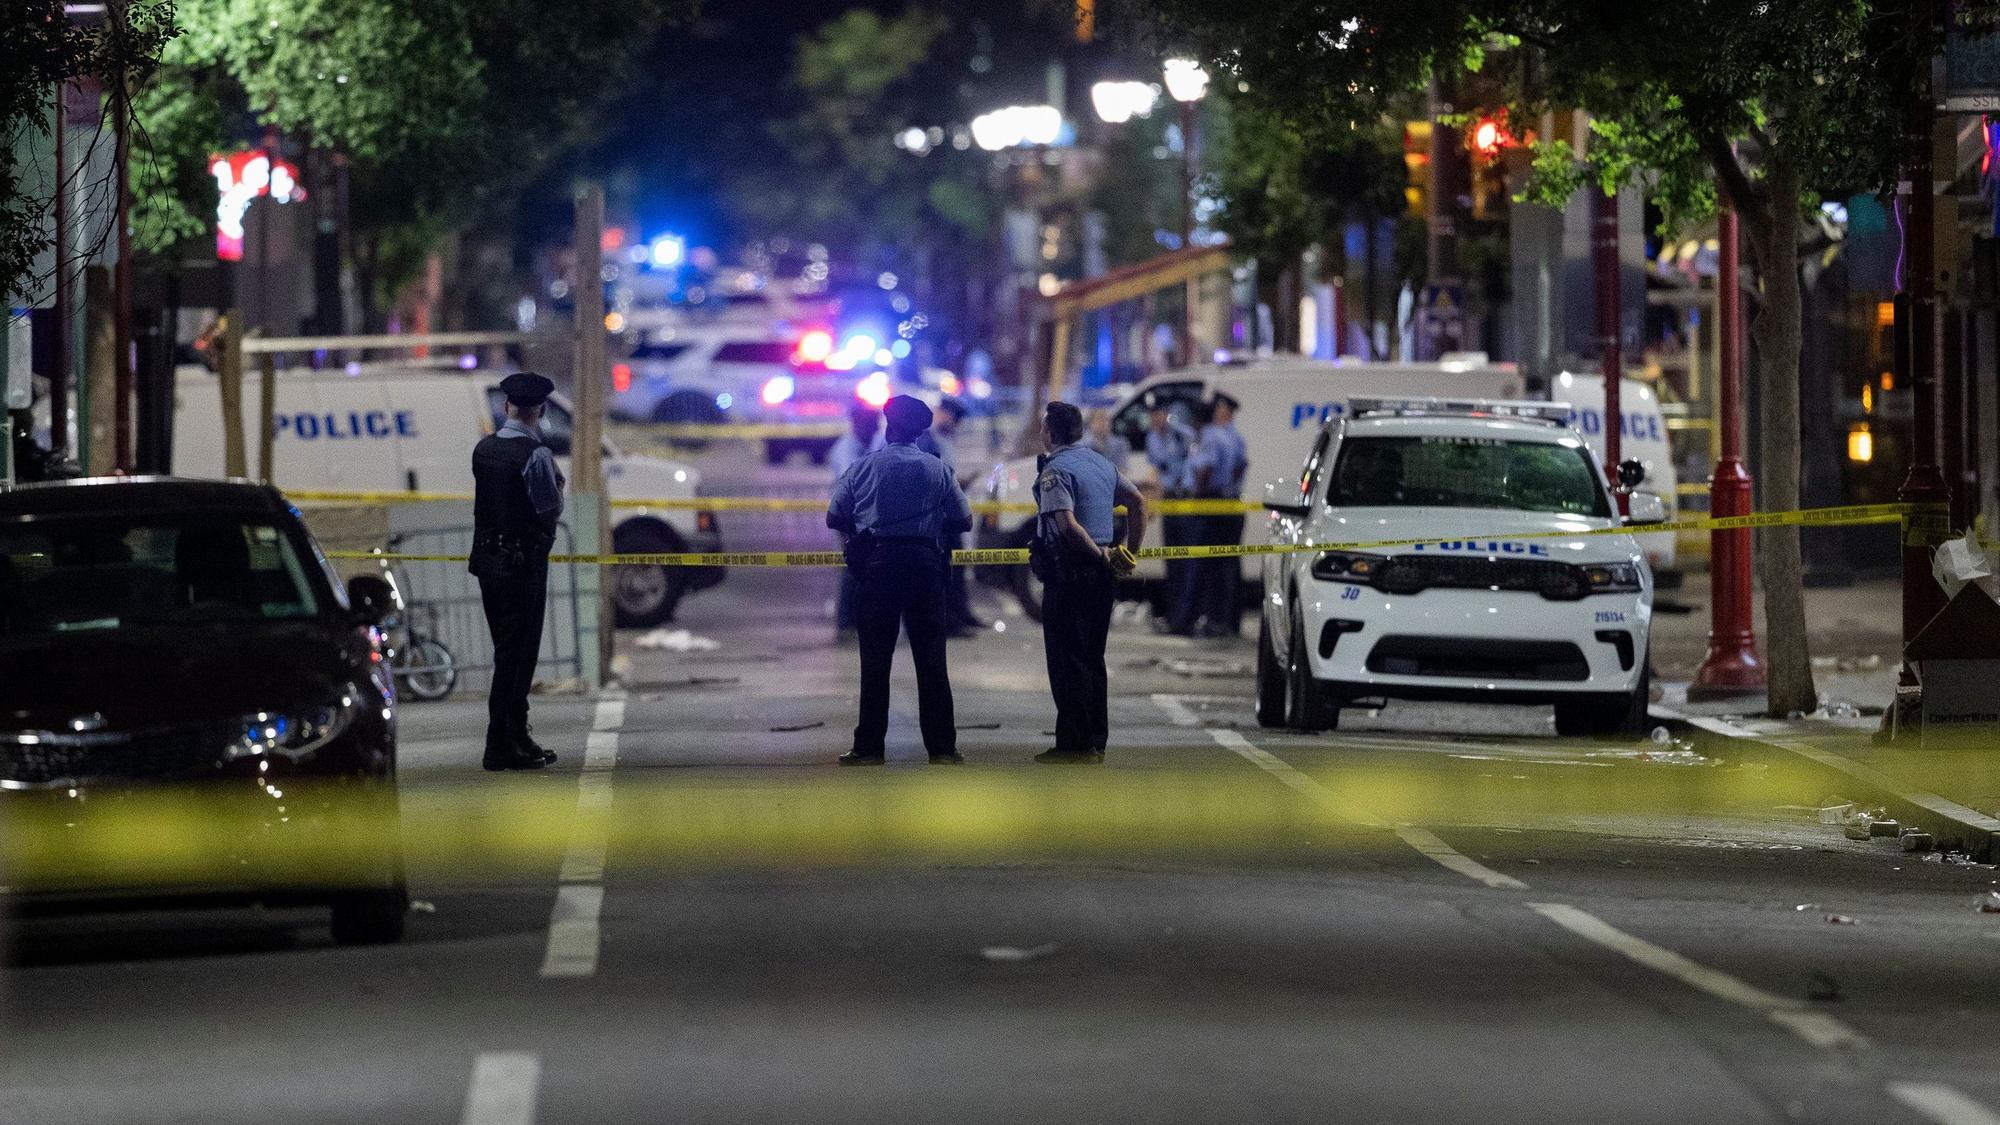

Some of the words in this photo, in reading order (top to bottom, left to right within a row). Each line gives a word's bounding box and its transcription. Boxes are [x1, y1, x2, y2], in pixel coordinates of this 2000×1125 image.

[272, 410, 419, 440] POLICE
[1142, 549, 1153, 558] LINE
[1154, 548, 1161, 558] DO
[1172, 548, 1188, 557] CROSS
[1208, 546, 1225, 554] POLICE
[956, 552, 972, 562] POLICE
[973, 552, 984, 562] LINE
[1341, 586, 1360, 600] 30
